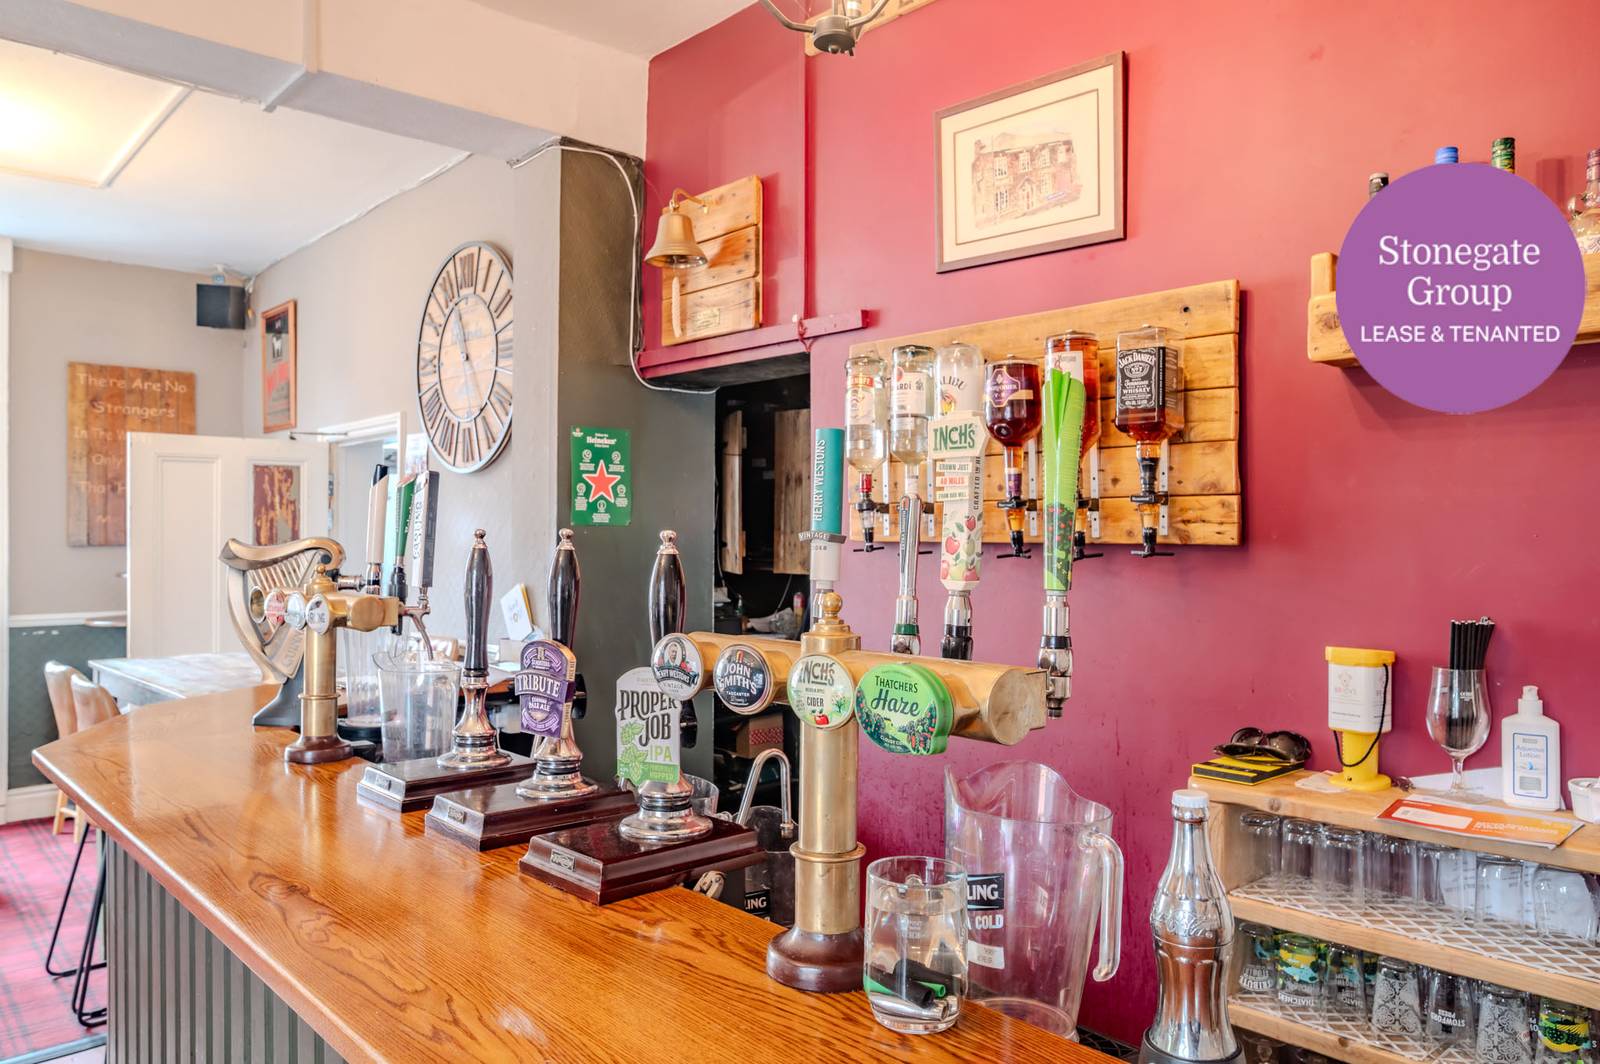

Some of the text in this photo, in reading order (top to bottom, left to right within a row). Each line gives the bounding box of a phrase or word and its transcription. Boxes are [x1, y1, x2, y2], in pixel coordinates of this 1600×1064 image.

[459, 253, 475, 289] XII
[1119, 354, 1132, 369] JACK
[76, 373, 187, 393] There Are No
[93, 401, 176, 418] Strangers
[73, 426, 88, 439] In
[933, 423, 976, 451] INCH'S
[92, 454, 123, 468] Only
[813, 439, 827, 521] HENRY WESTONS
[799, 532, 829, 541] VINTAGE
[725, 662, 751, 678] JOHN
[517, 674, 561, 698] TRIBUTE
[719, 674, 757, 696] SMITH'S
[875, 675, 919, 694] THATCHERS
[528, 702, 551, 712] PALE ALE
[617, 689, 678, 721] PROPER
[806, 696, 824, 707] CIDER
[870, 688, 921, 717] Haze
[638, 713, 672, 747] JOB
[650, 745, 673, 761] IPA
[975, 914, 1004, 930] COLD
[1431, 1012, 1466, 1028] STOWFORD
[1438, 1009, 1456, 1019] PRESS
